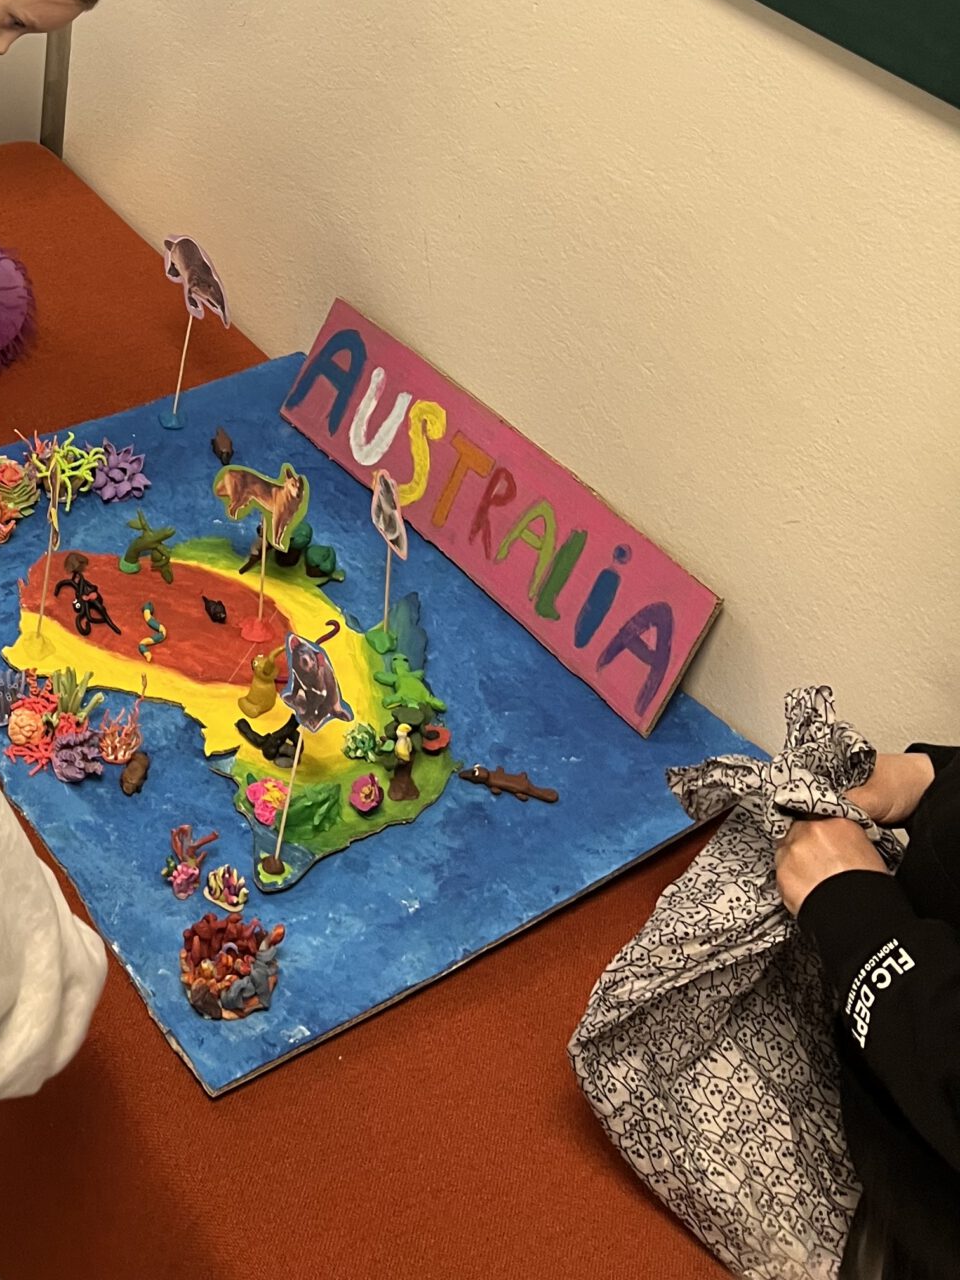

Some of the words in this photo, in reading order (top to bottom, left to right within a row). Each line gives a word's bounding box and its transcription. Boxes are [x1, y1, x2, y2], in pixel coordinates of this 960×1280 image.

[871, 947, 916, 990] FLC
[877, 937, 899, 960] FROM
[851, 983, 876, 1049] DEPT
